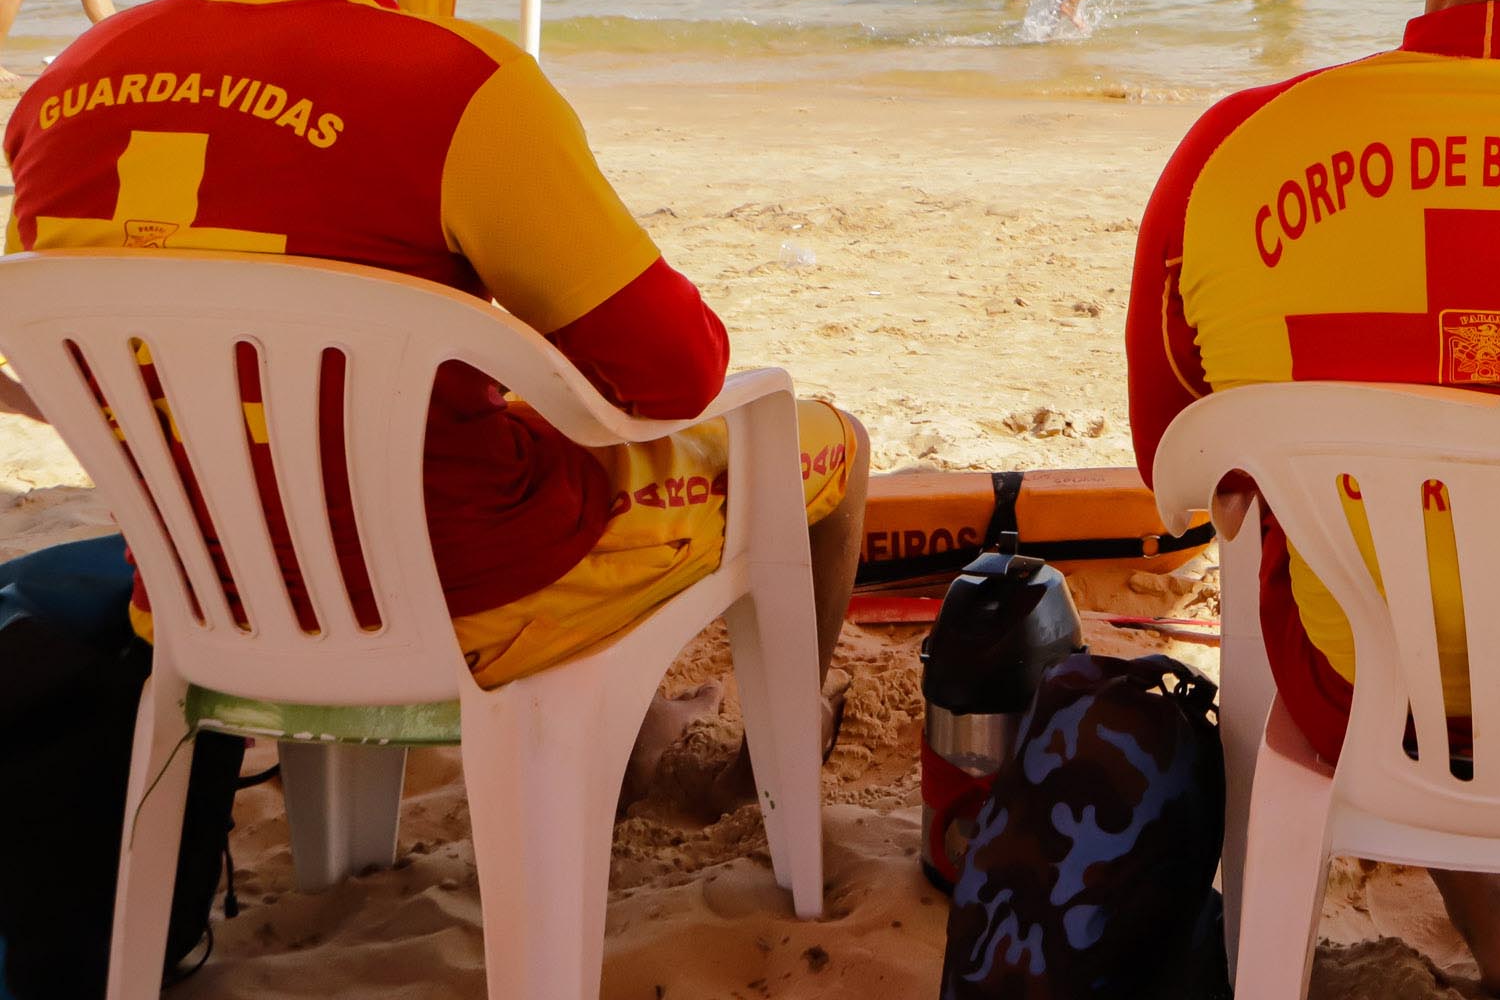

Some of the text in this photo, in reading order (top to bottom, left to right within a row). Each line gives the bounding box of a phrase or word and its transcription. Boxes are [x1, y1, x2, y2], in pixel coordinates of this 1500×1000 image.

[39, 72, 345, 149] GUARDA-VIDAS
[1254, 141, 1395, 269] CORPO
[1410, 135, 1468, 191] DE
[859, 526, 977, 564] EIROS
